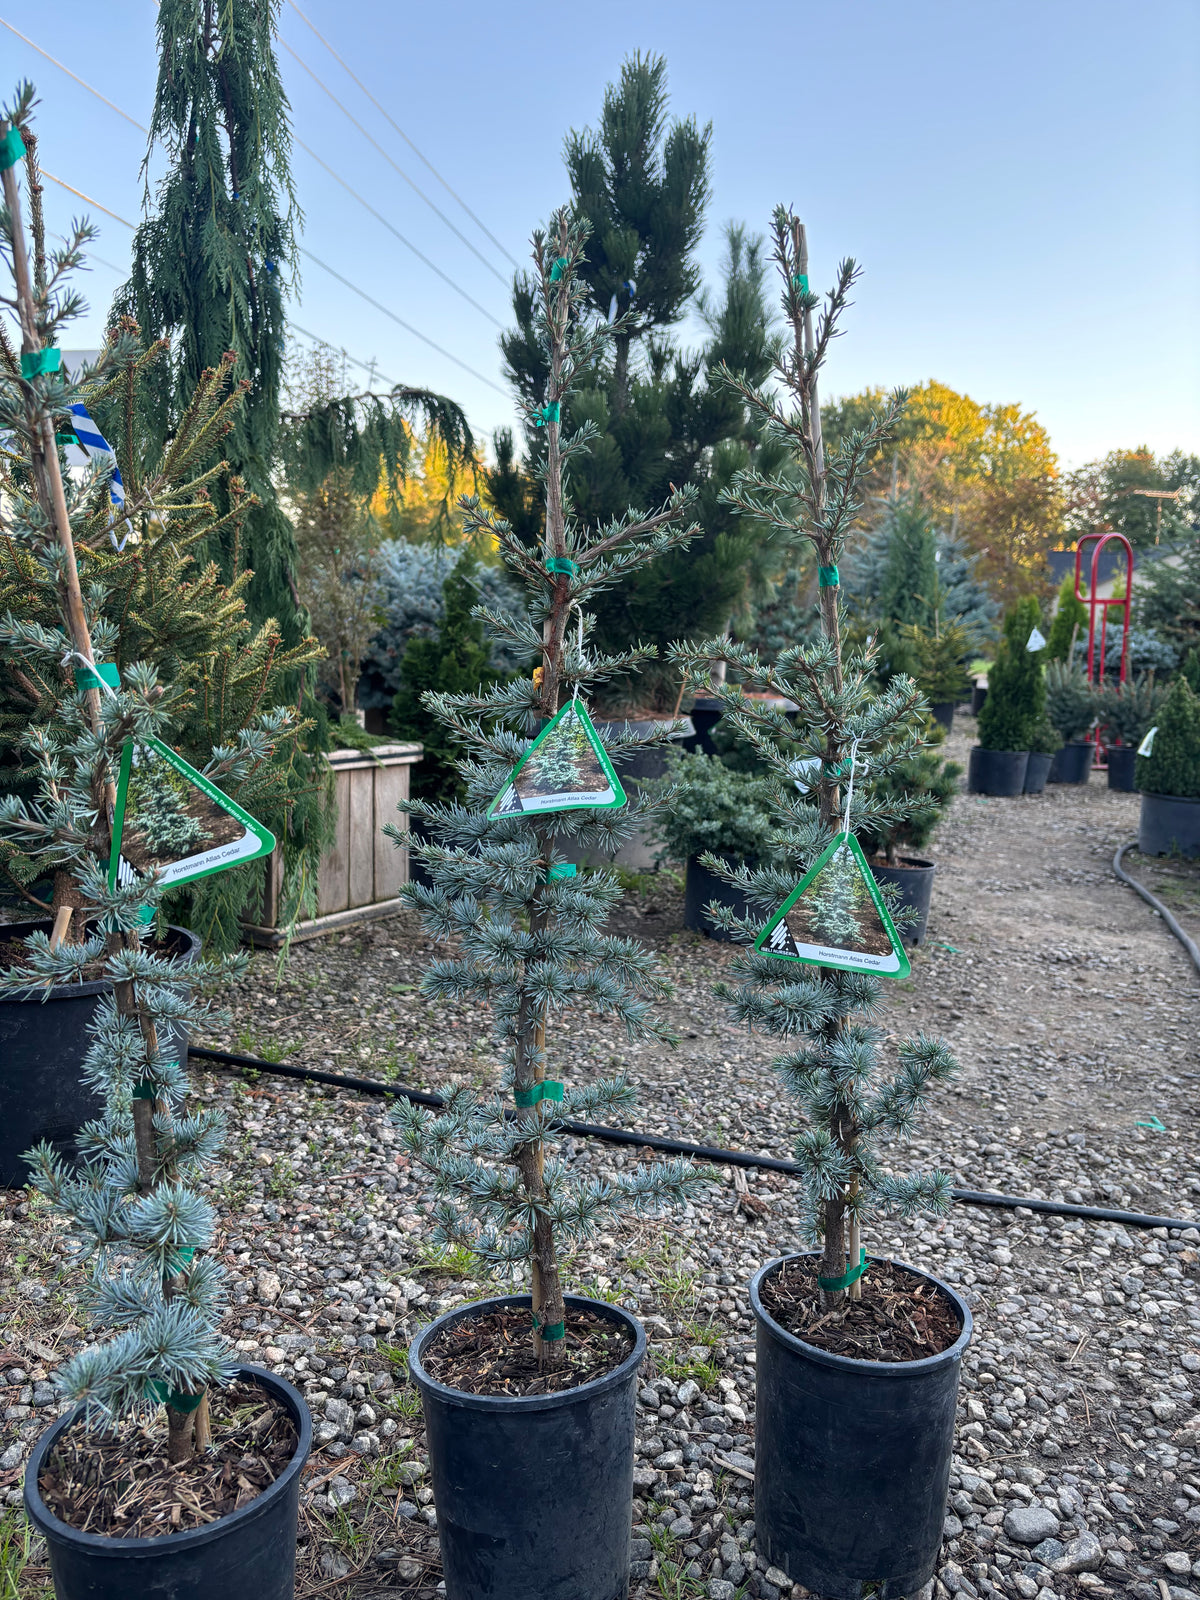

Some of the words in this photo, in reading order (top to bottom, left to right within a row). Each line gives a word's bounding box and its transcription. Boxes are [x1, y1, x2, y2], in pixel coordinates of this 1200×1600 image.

[206, 788, 219, 800] Meets
[226, 806, 242, 820] Artistry
[172, 860, 205, 875] Horstmann
[205, 854, 220, 863] Atlas
[221, 847, 240, 858] Cedar
[818, 950, 848, 961] Horstmann
